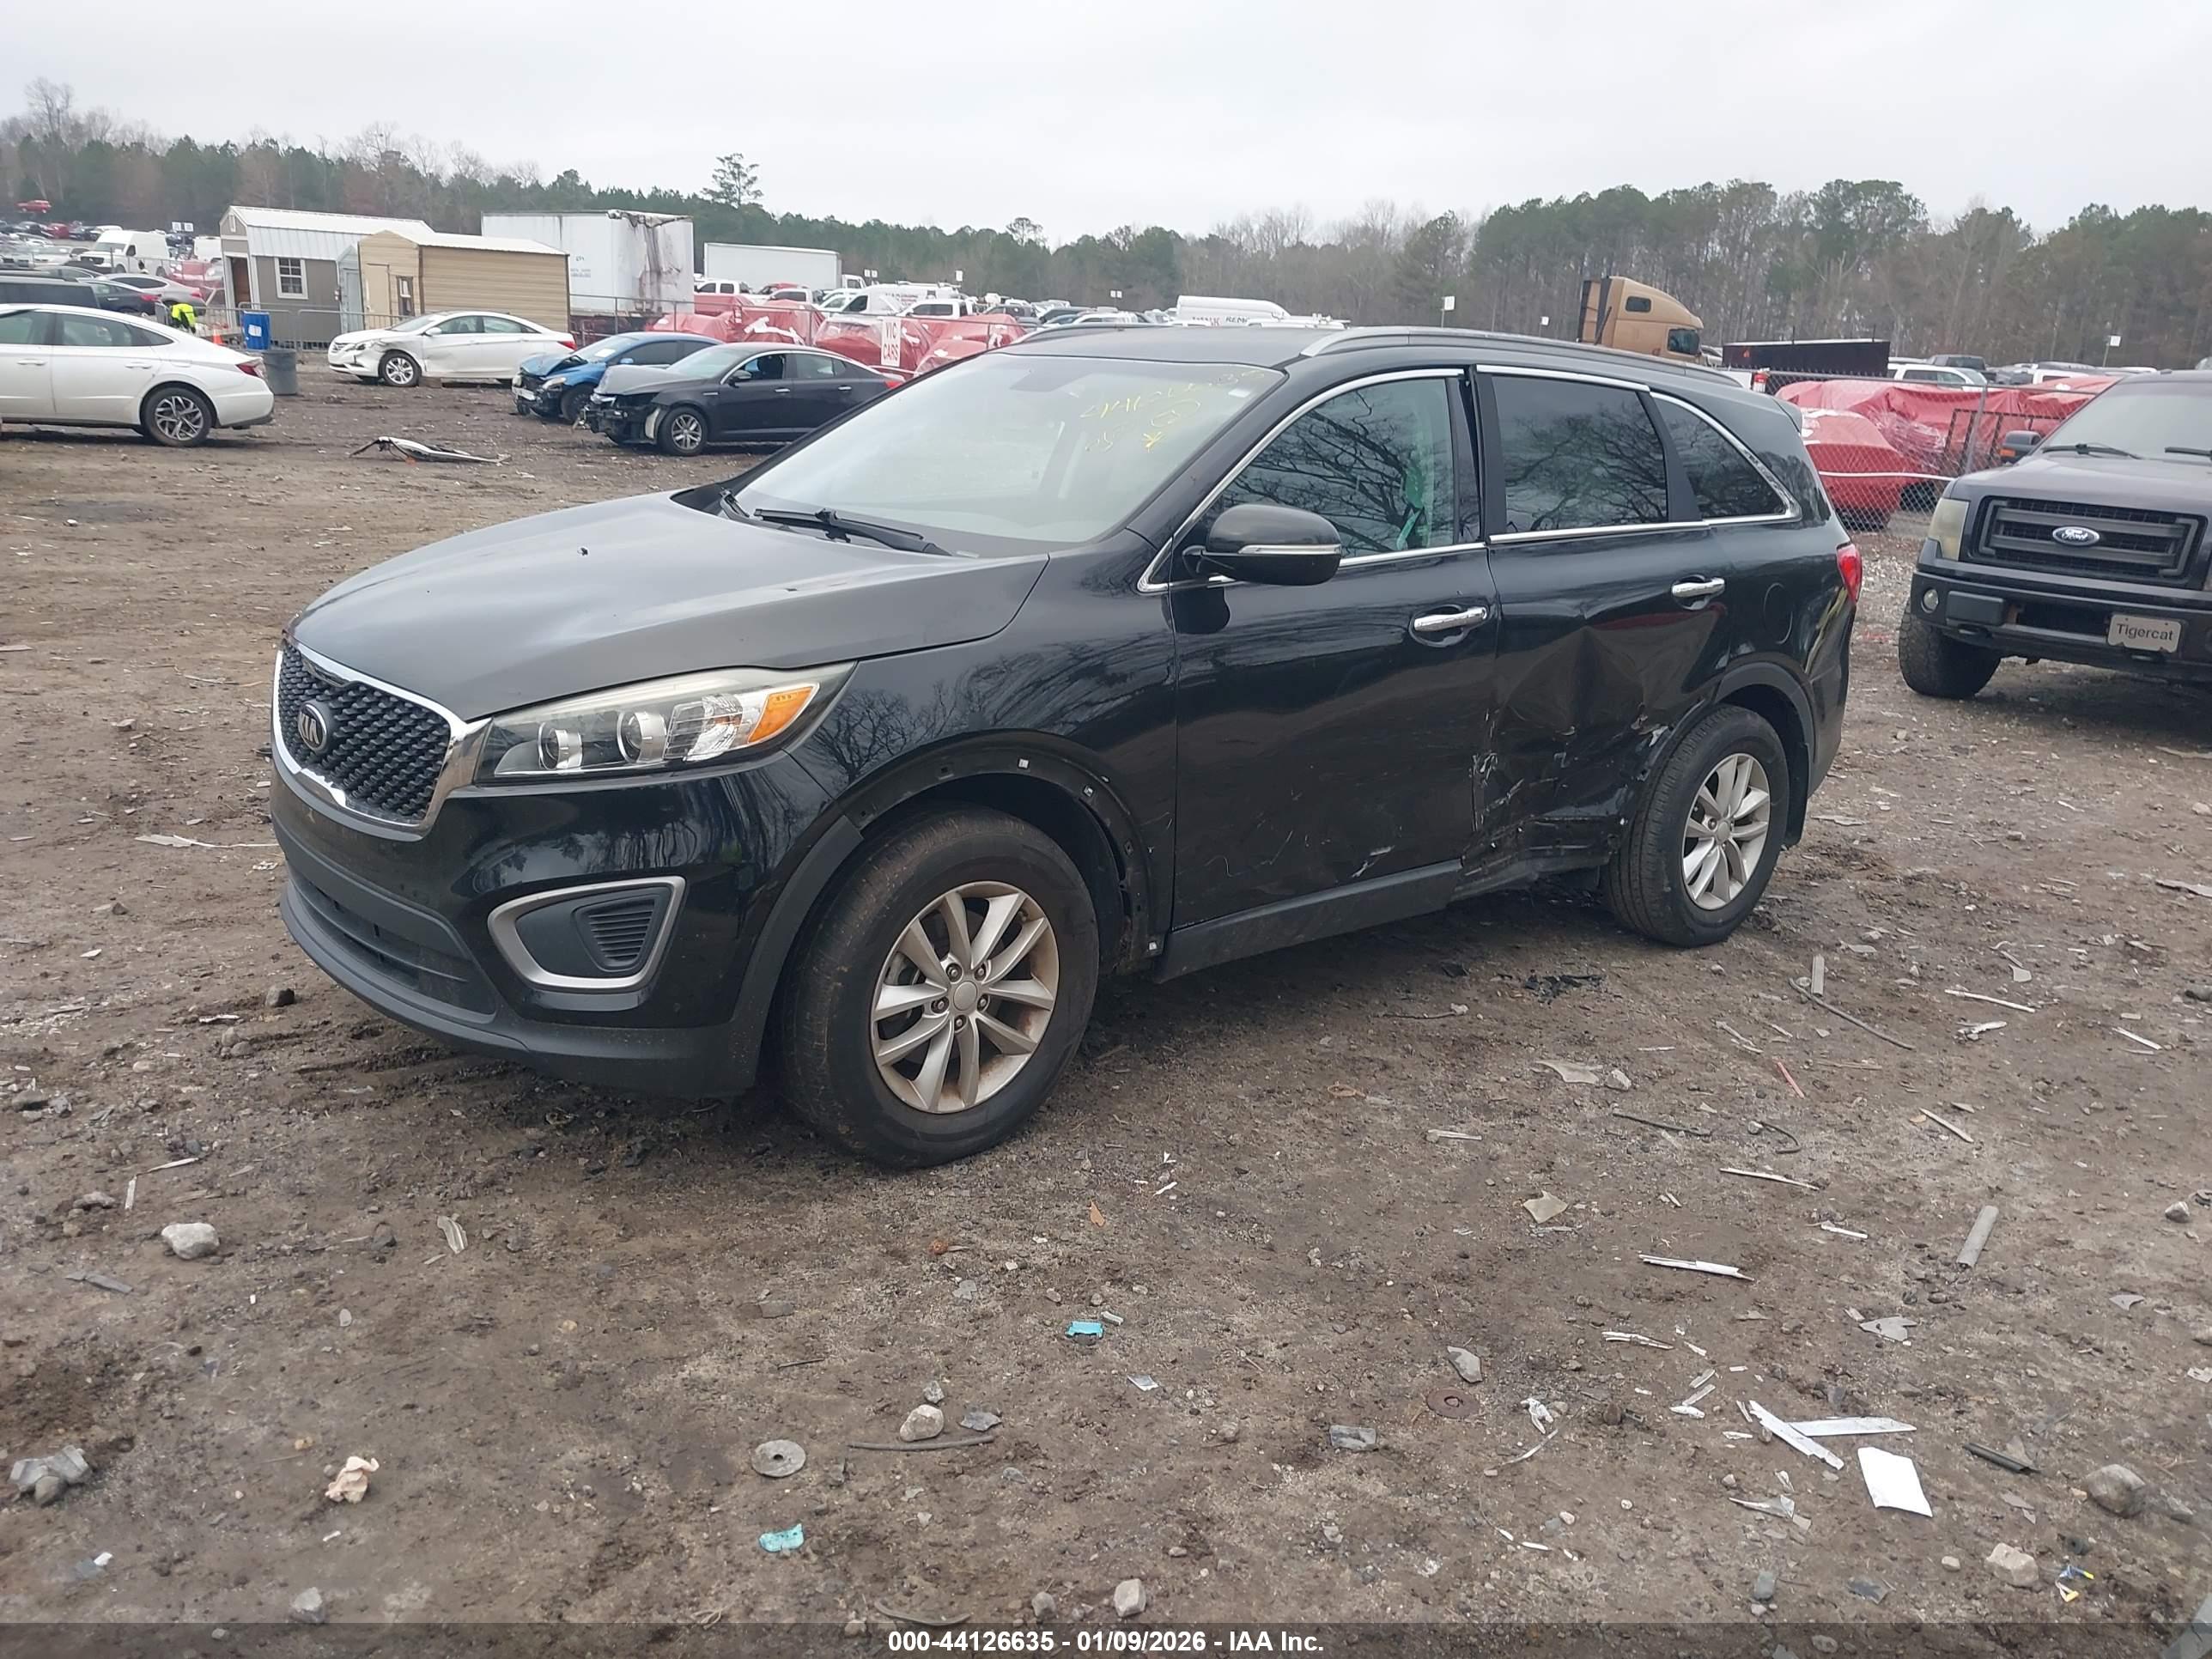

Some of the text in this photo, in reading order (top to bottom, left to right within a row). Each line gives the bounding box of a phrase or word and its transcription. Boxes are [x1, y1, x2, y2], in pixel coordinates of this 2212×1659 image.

[883, 343, 899, 362] CARS
[2117, 623, 2174, 641] Tigercat
[298, 711, 320, 745] KIA
